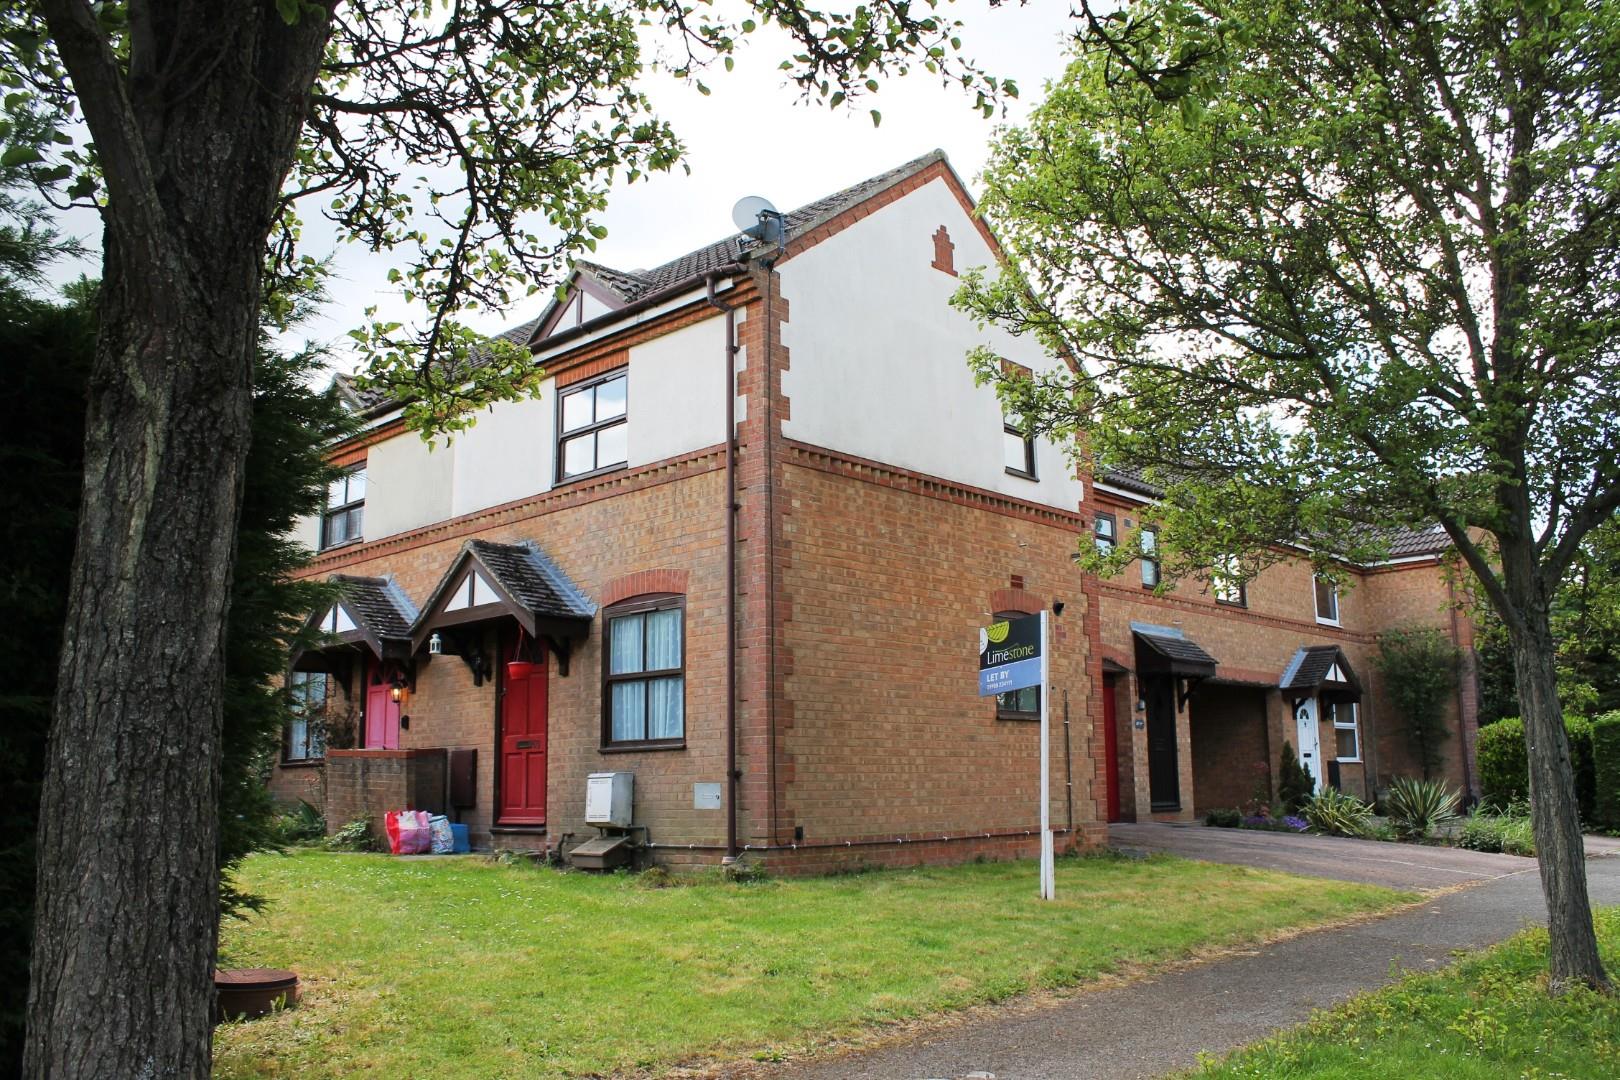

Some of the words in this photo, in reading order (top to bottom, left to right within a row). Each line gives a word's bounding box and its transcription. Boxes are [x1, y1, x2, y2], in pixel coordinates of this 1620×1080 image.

[987, 645, 1034, 665] Limestone
[986, 672, 999, 683] LET
[1000, 670, 1009, 680] BY
